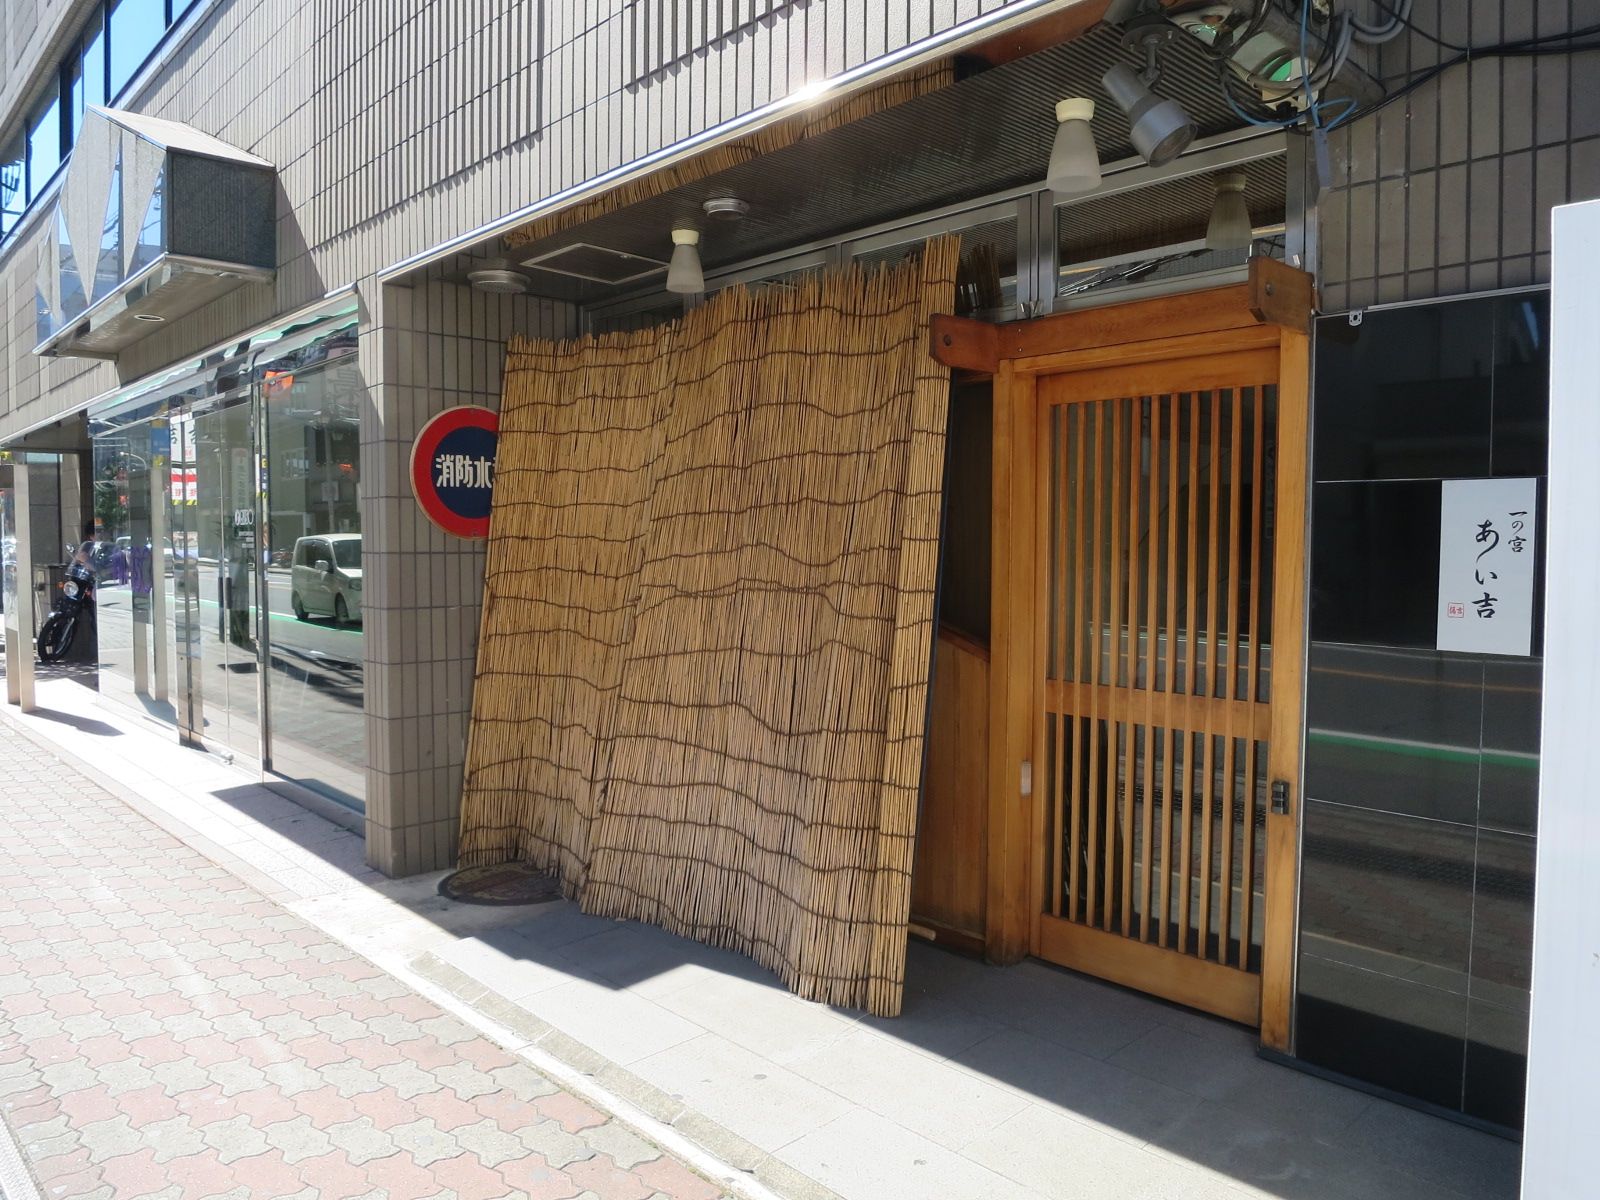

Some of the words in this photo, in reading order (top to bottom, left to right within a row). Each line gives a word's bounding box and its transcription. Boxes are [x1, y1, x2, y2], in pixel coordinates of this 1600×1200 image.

[435, 454, 497, 489] 消防水
[1507, 510, 1528, 553] 一の宮
[1471, 519, 1500, 619] あい吉
